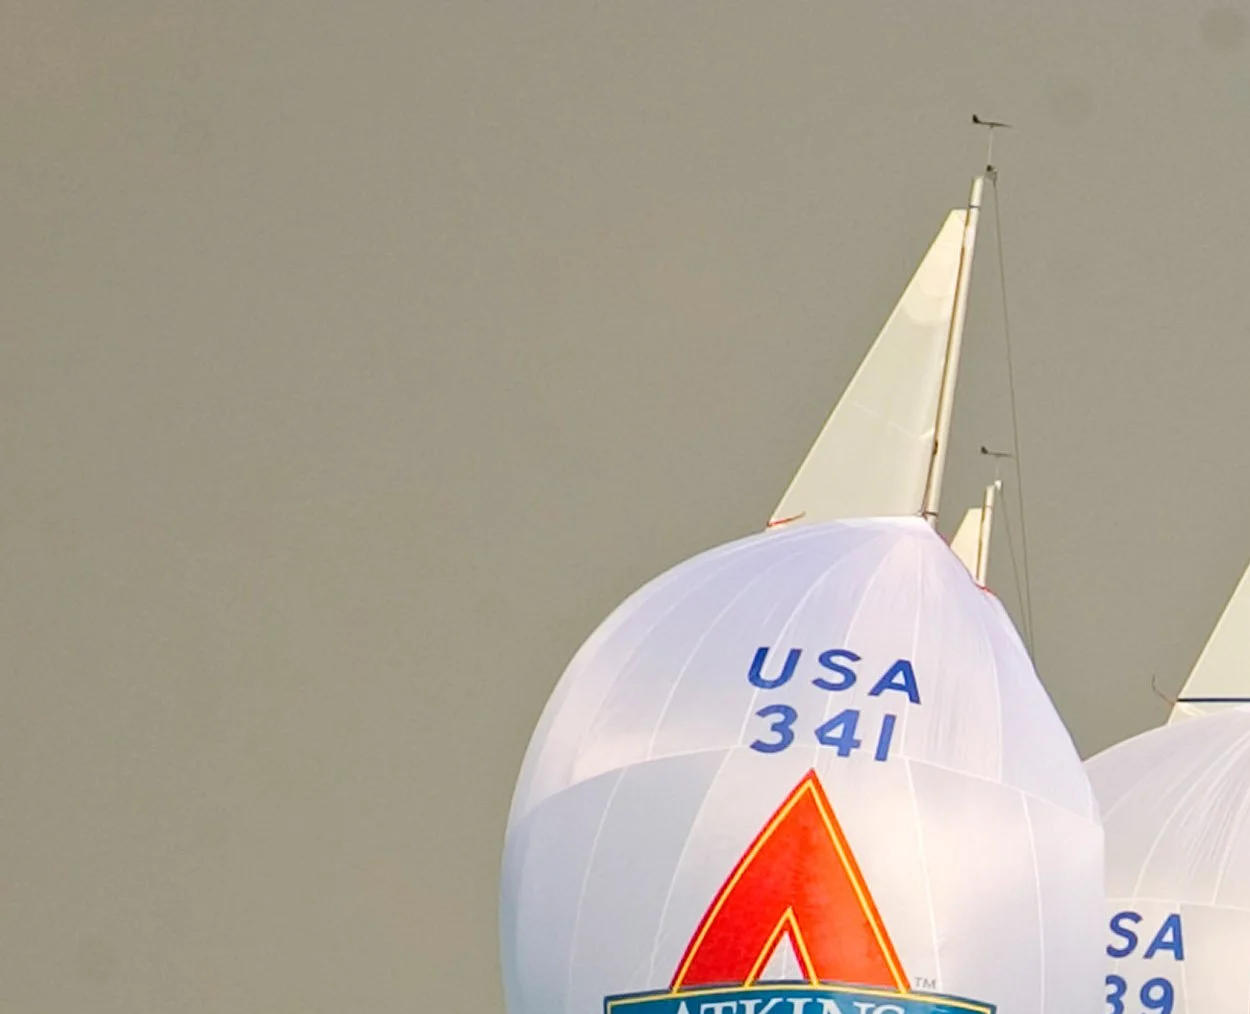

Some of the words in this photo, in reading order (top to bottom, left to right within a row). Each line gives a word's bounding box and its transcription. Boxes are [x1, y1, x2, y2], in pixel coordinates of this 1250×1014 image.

[747, 646, 922, 704] USA
[749, 704, 897, 762] 341
[1105, 910, 1185, 961] SA
[914, 976, 937, 990] TM
